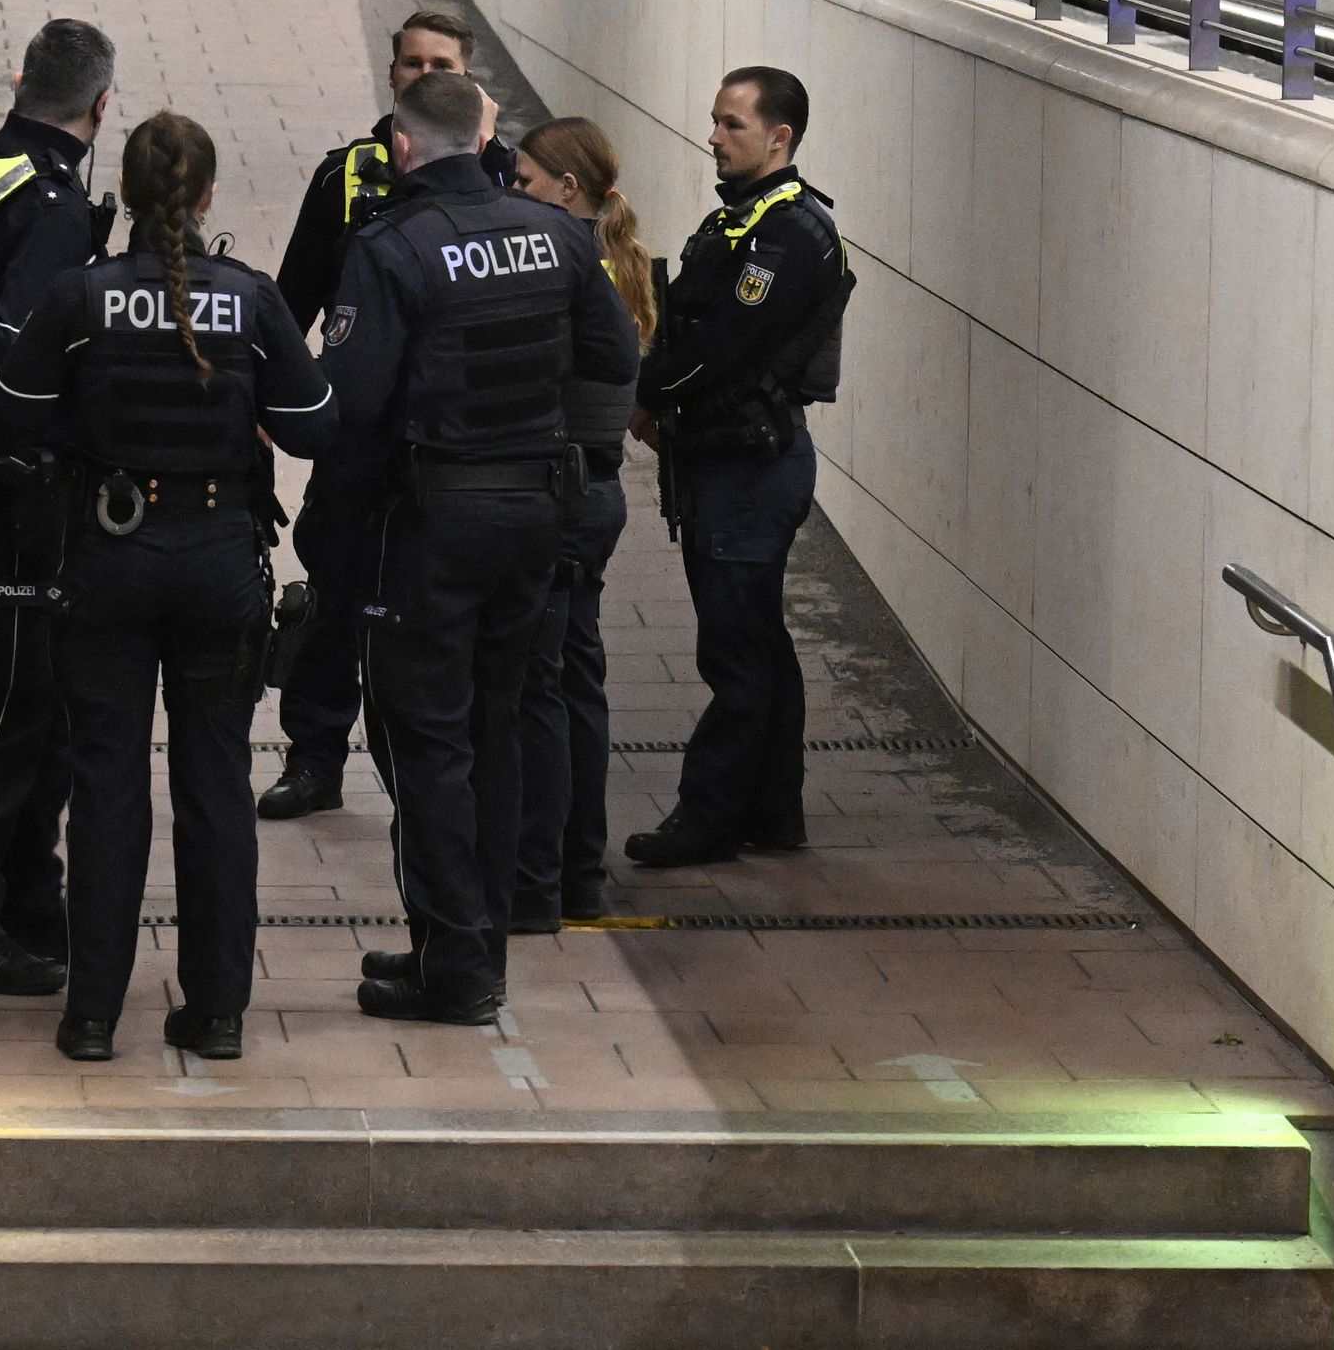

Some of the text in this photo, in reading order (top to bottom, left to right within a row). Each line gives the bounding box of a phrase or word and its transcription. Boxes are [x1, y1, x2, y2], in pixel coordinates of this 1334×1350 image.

[440, 233, 560, 282] POLIZEI
[746, 265, 772, 282] POLIZEI
[104, 288, 241, 333] POLZEI
